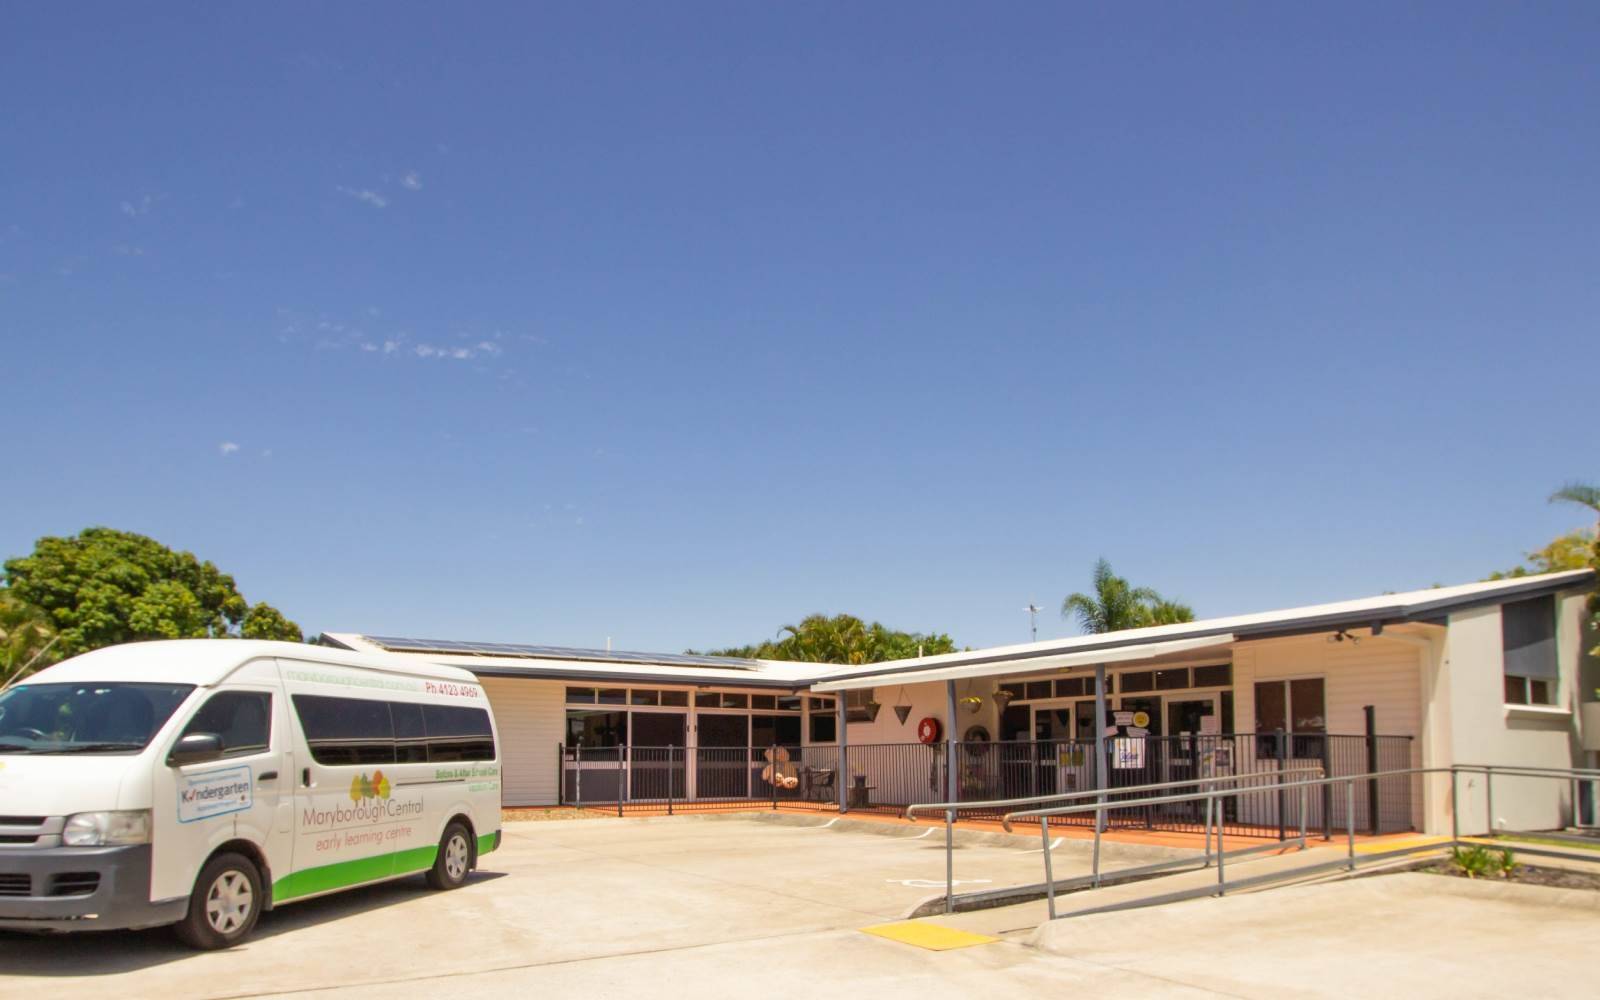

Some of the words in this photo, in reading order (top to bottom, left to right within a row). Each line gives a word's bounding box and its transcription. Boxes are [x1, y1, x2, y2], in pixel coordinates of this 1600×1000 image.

[439, 683, 459, 696] 4123
[460, 686, 478, 697] 4969
[302, 799, 386, 827] Maryborough
[387, 794, 424, 817] Central
[316, 831, 342, 851] early
[345, 831, 384, 847] learning
[385, 826, 412, 841] centre
